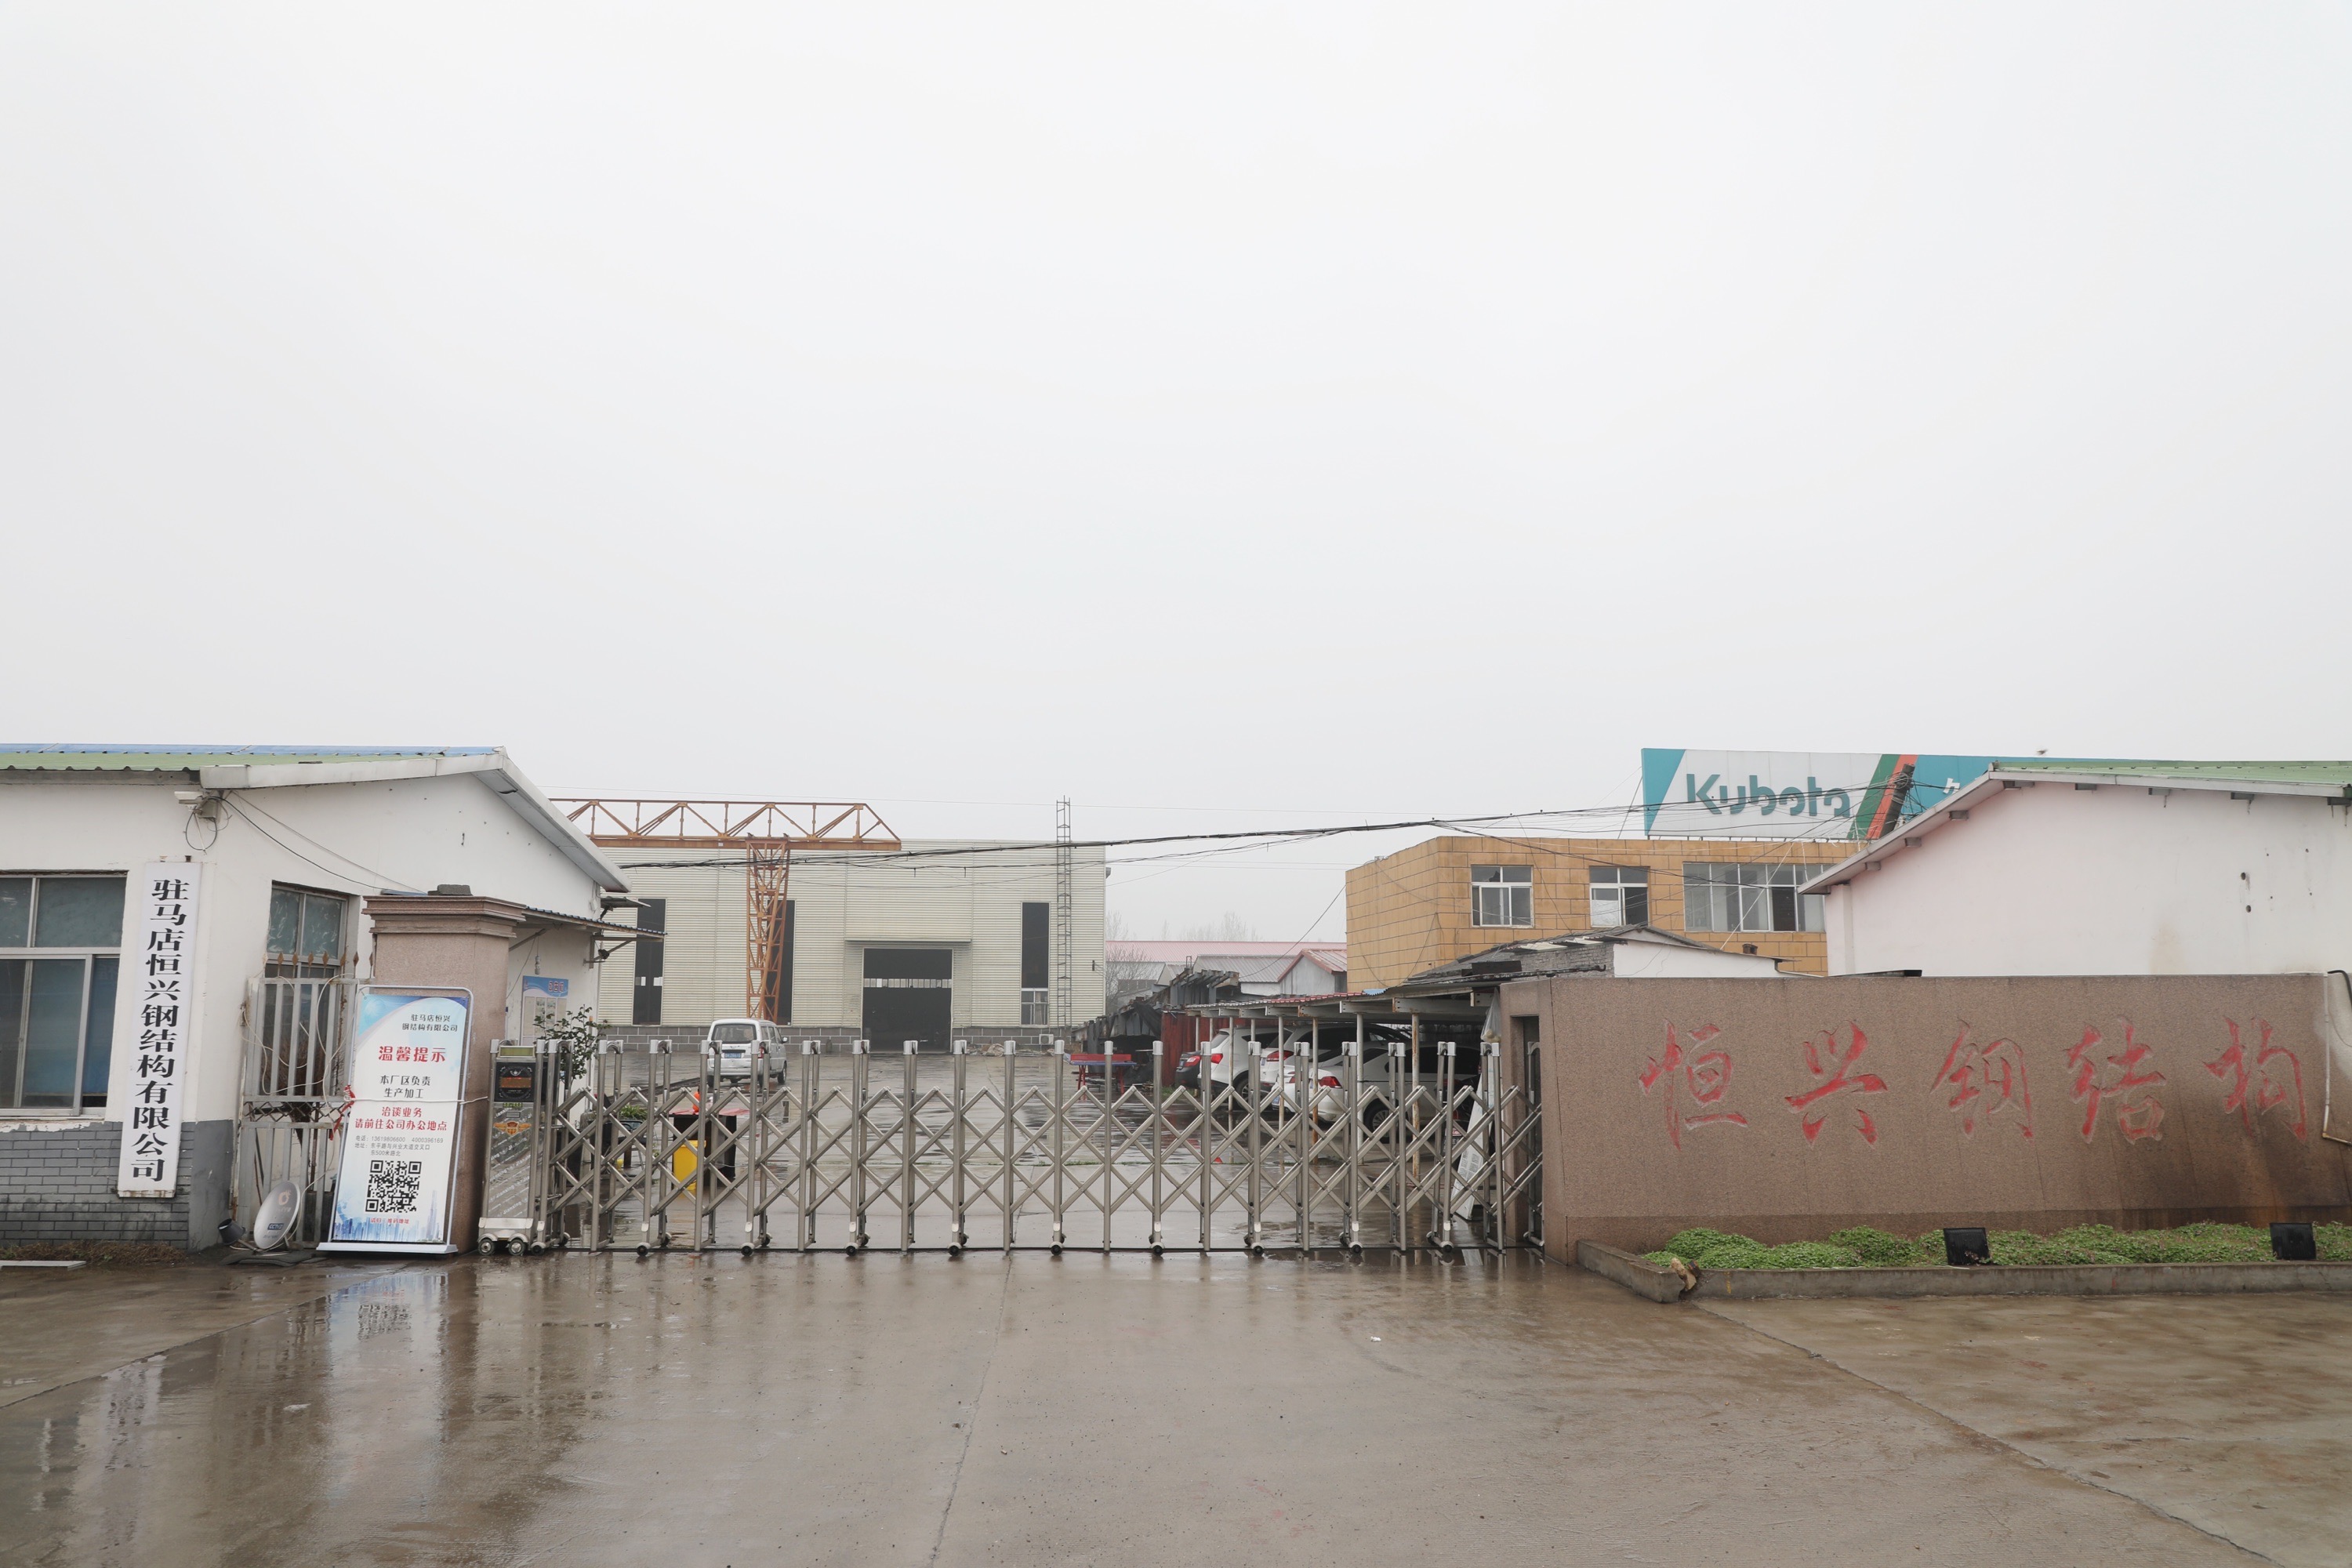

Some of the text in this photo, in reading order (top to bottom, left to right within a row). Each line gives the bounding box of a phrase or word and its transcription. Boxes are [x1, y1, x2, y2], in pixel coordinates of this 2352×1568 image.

[1686, 773, 1851, 818] Kubota
[410, 1014, 451, 1022] 驻马店恒兴
[130, 878, 191, 1182] 驻马店恒兴钢结构有限公司
[401, 1022, 458, 1033] 钢结构有限公司
[378, 1045, 446, 1063] 温馨提示
[379, 1075, 431, 1087] 本厂区负责
[1639, 1017, 2307, 1151] 恒兴钢结构
[383, 1087, 424, 1099] 生产加工
[381, 1106, 423, 1118] 洽谈业务
[354, 1118, 448, 1131] 请前往公司办公地点
